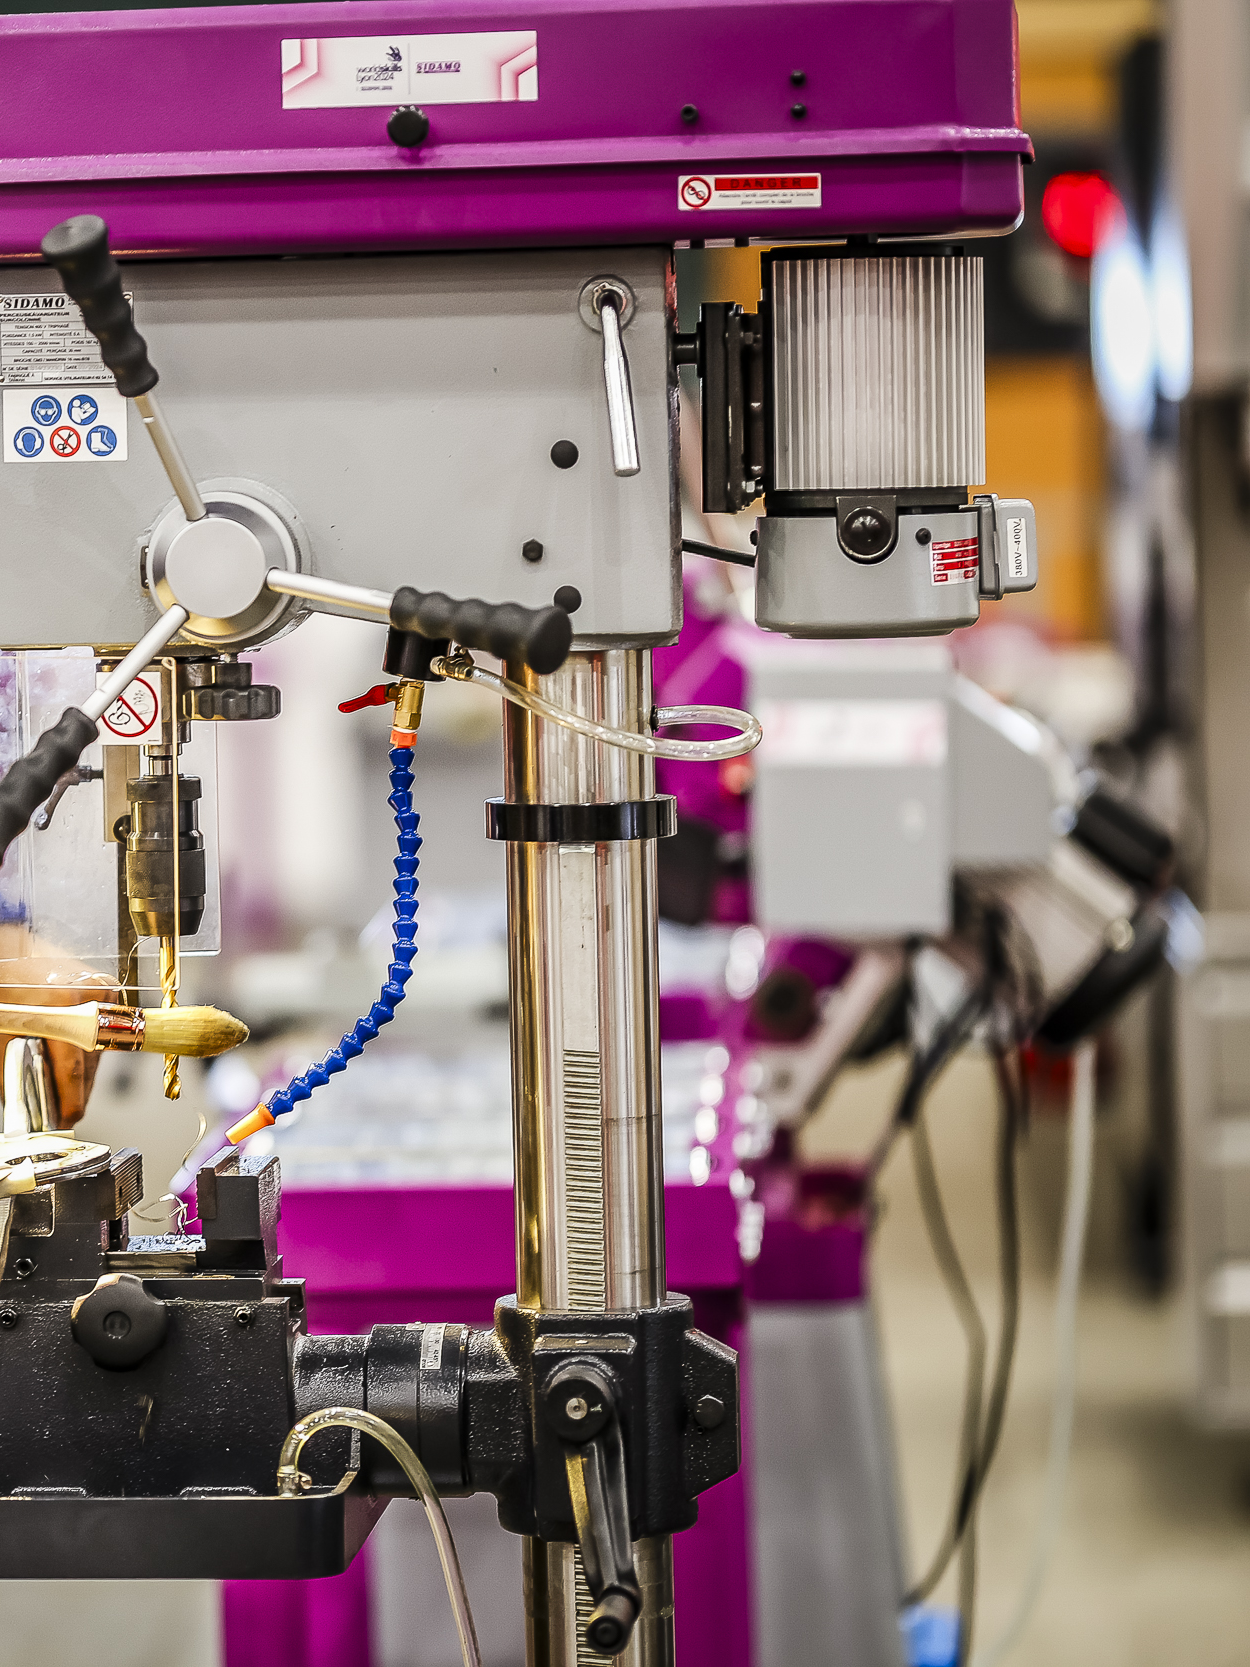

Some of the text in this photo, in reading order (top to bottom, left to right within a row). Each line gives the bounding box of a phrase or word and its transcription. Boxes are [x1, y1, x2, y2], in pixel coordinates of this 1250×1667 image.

[416, 62, 461, 73] SIDAMO
[730, 178, 802, 189] DANGER
[4, 298, 65, 309] SIDAMO
